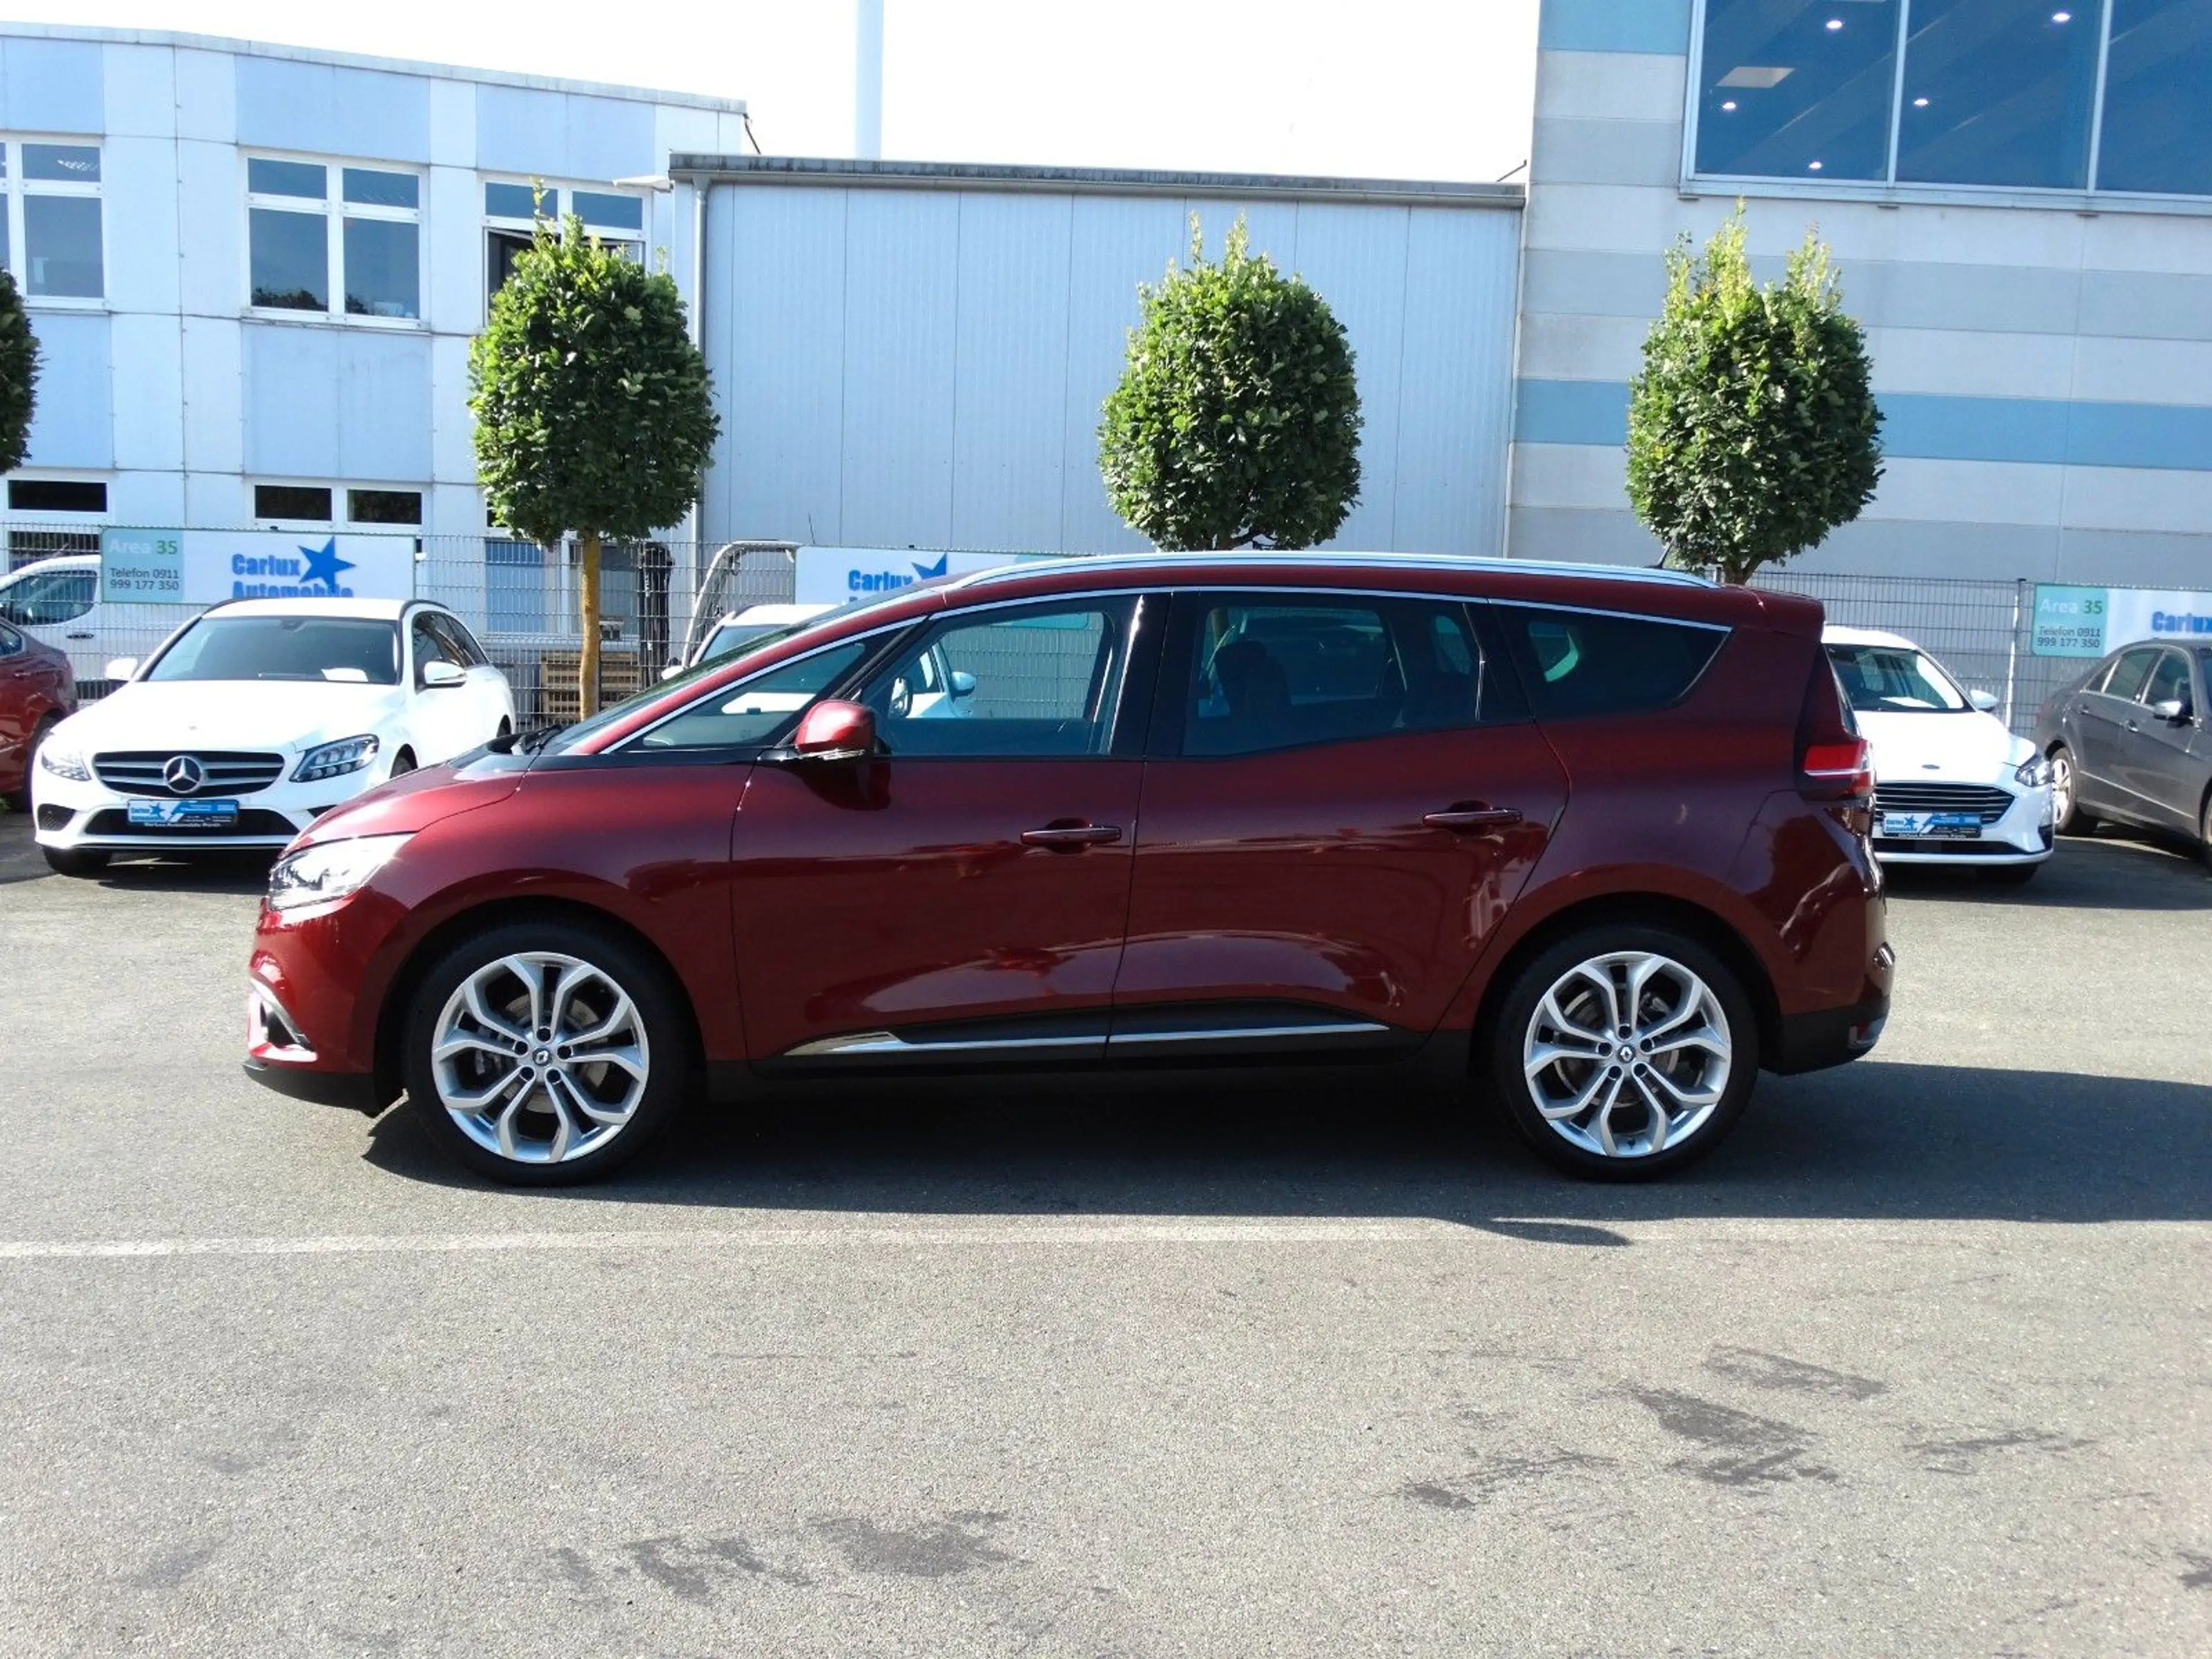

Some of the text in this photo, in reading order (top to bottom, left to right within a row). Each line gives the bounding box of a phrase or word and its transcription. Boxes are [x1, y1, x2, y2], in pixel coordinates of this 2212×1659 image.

[109, 539, 177, 555] Area 35
[232, 554, 300, 575] Carlux
[109, 567, 179, 579] Telefon 0911
[110, 579, 179, 590] 999 177 350
[2040, 599, 2103, 614] Area 35
[2039, 626, 2100, 637] Telefon 0911
[2037, 637, 2100, 648] 999 177 350
